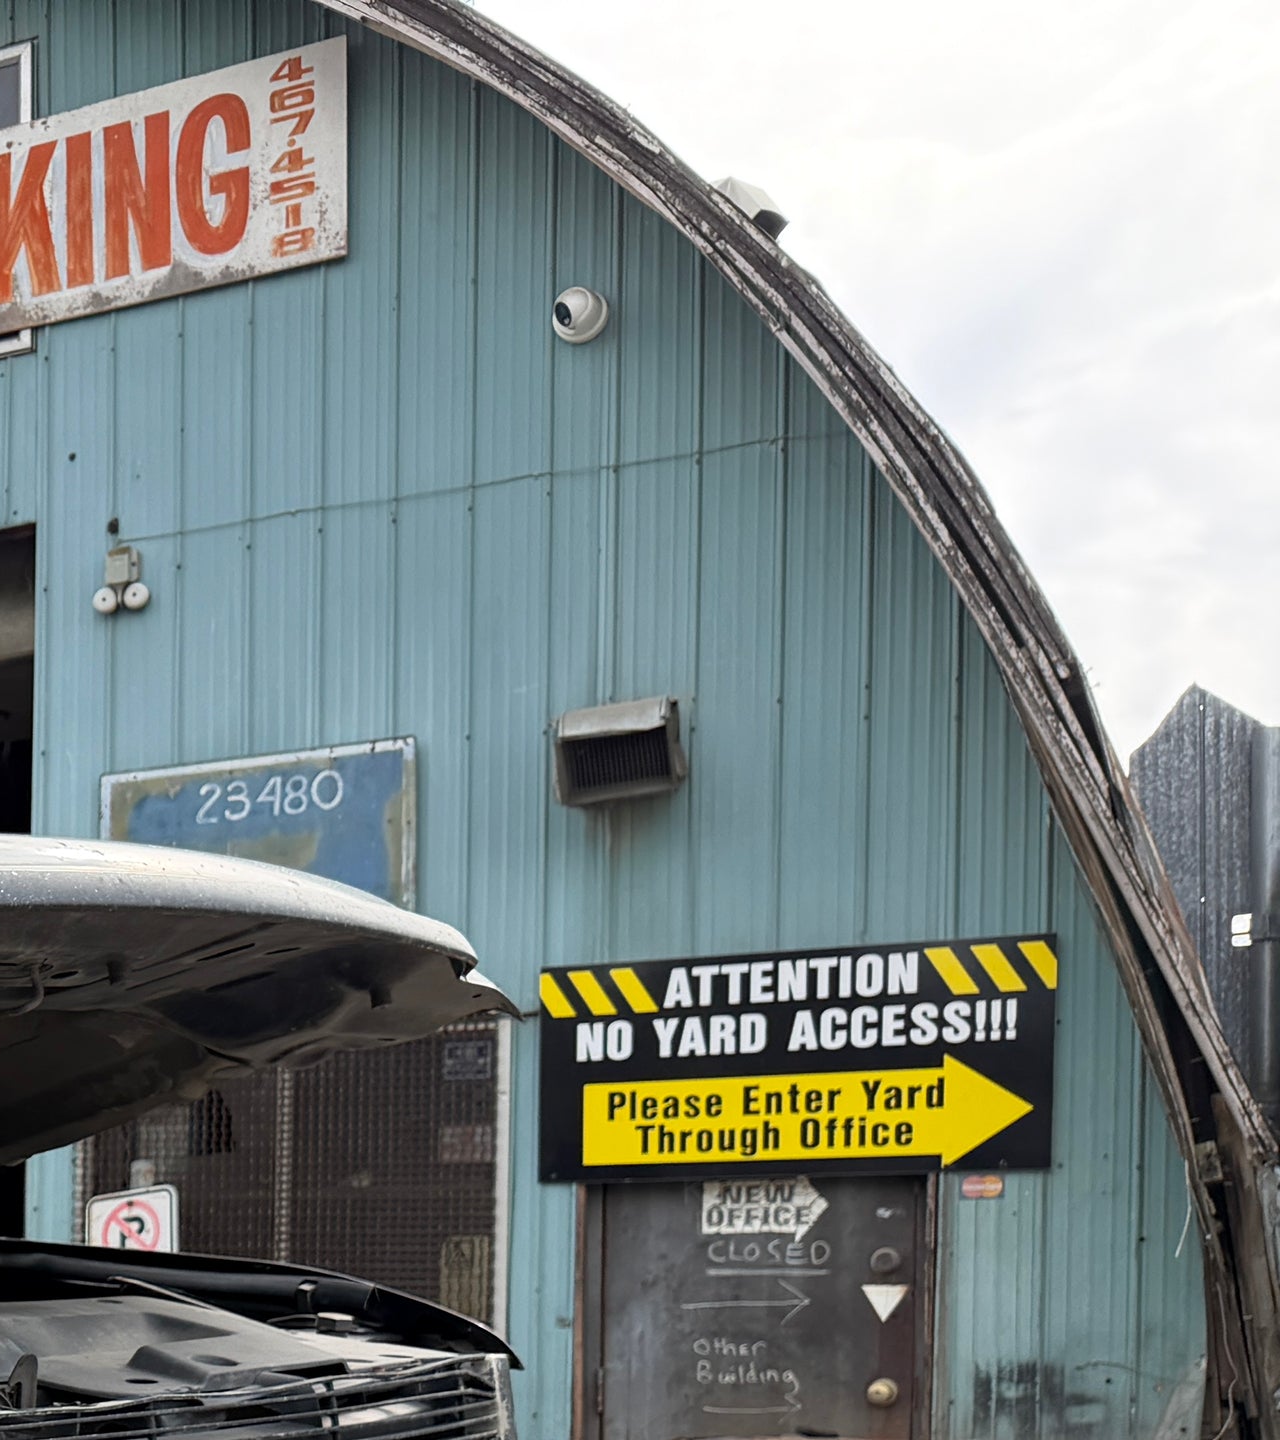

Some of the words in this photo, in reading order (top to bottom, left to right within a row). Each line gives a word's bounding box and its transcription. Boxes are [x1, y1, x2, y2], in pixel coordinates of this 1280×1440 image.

[196, 769, 344, 824] 23480
[662, 951, 919, 1009] ATTENTION
[575, 1019, 634, 1062] NO
[652, 1012, 768, 1058] YARD
[787, 998, 1018, 1051] ACCESS!!!
[608, 1091, 723, 1121] Please
[742, 1083, 841, 1116] Enter
[861, 1076, 945, 1111] Yard
[635, 1120, 780, 1156] Through
[800, 1116, 914, 1149] Office
[718, 1181, 794, 1203] NEW
[707, 1204, 811, 1227] OFFICE
[708, 1238, 831, 1265] CLOSED
[696, 1359, 799, 1394] Building
